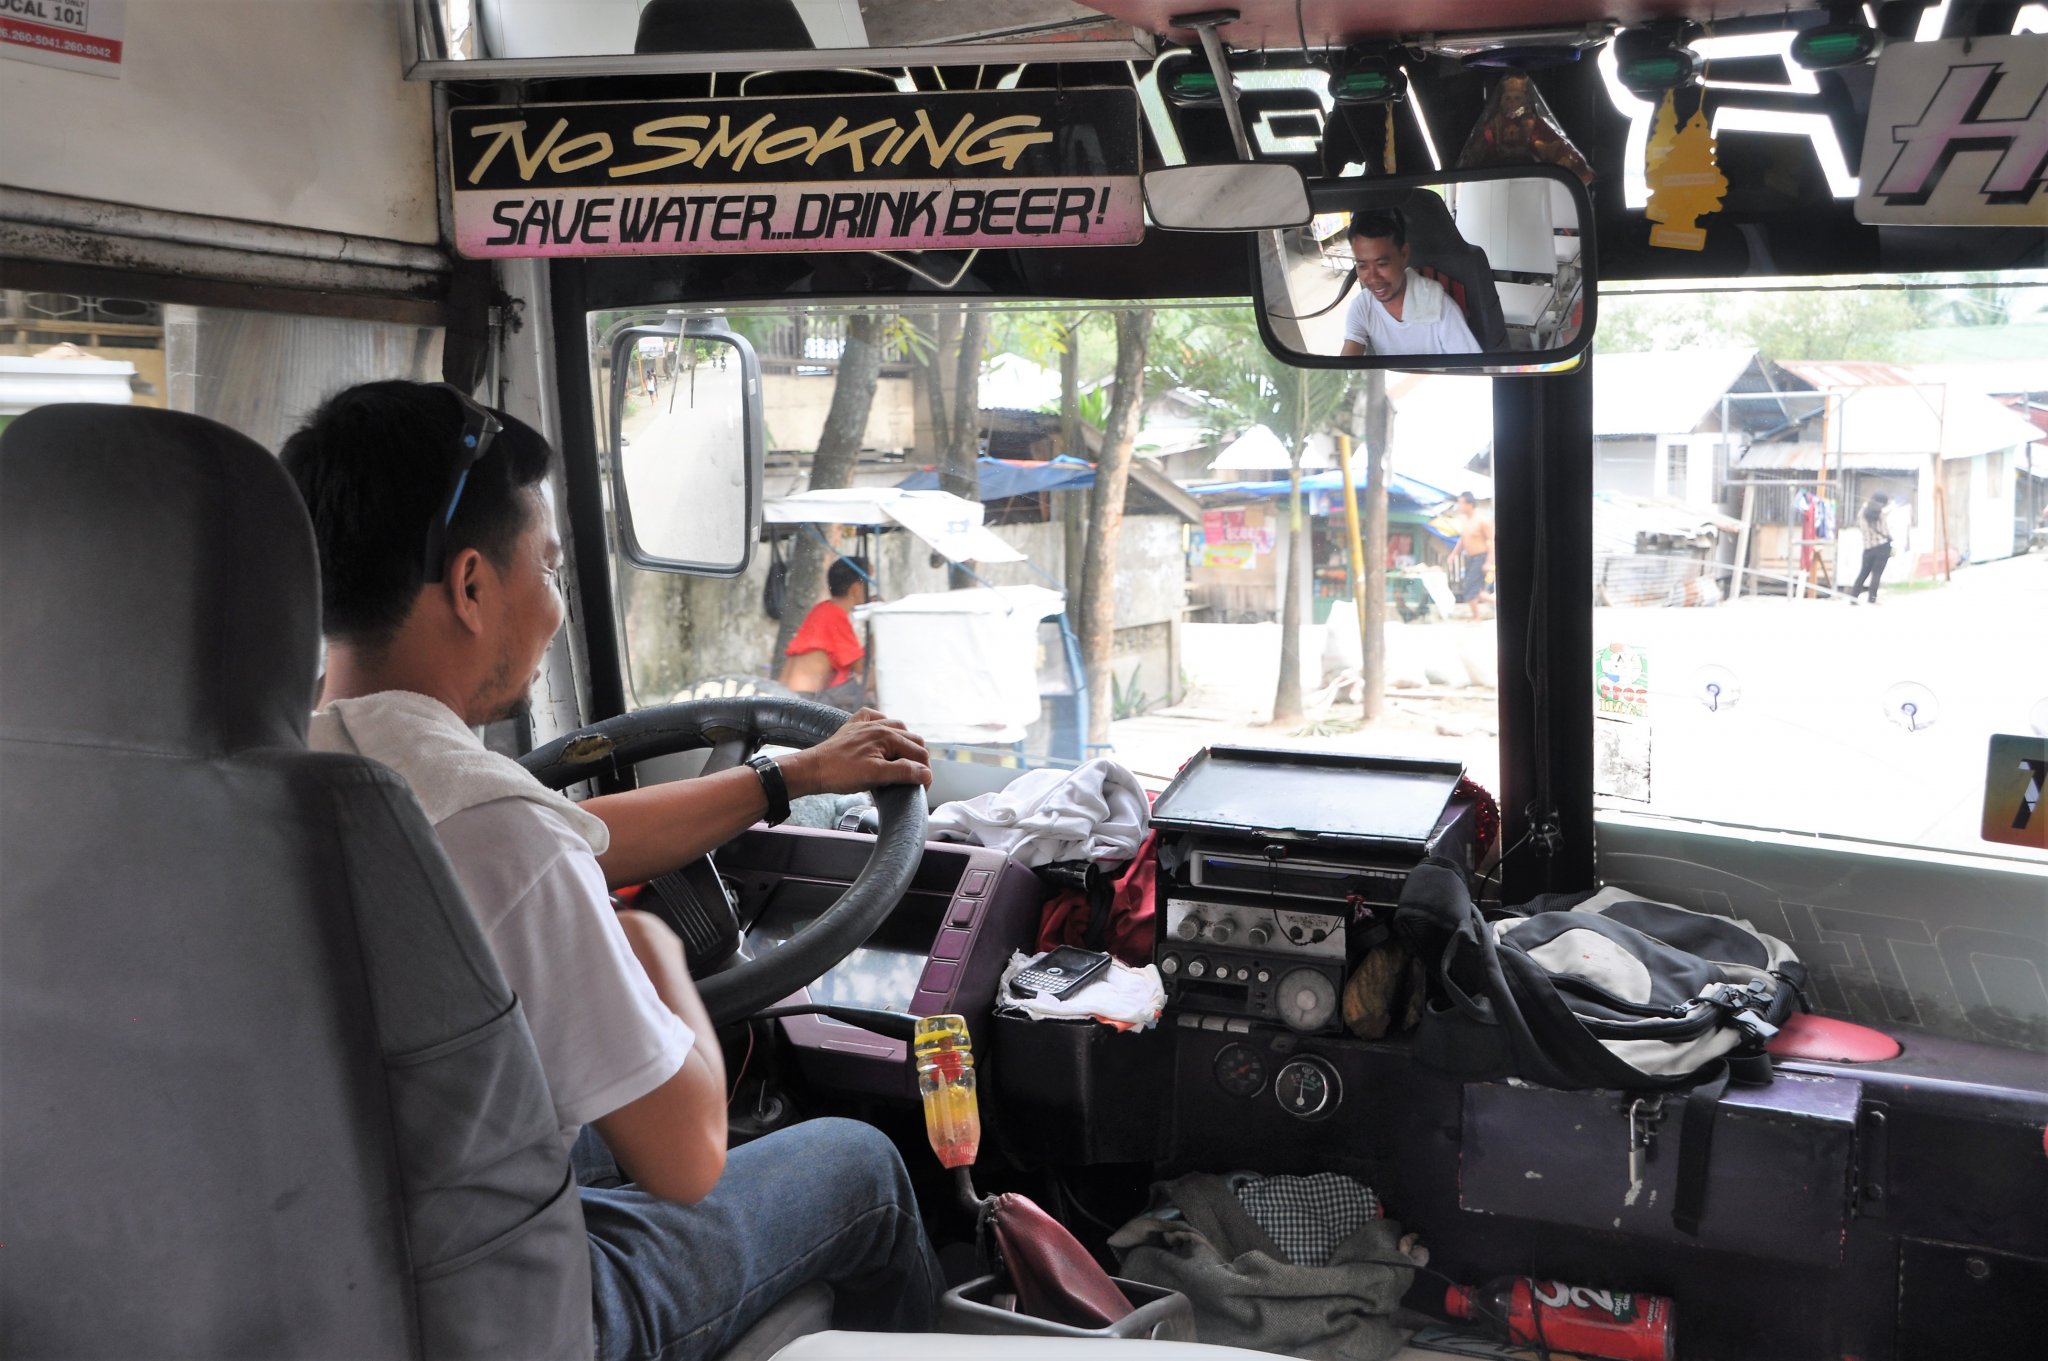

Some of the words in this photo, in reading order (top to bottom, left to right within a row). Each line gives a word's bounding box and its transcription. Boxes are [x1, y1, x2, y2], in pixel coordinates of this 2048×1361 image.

[54, 6, 84, 26] 101
[608, 109, 1053, 178] SMOKING
[486, 198, 615, 246] SAVE
[943, 187, 1110, 236] BEER!
